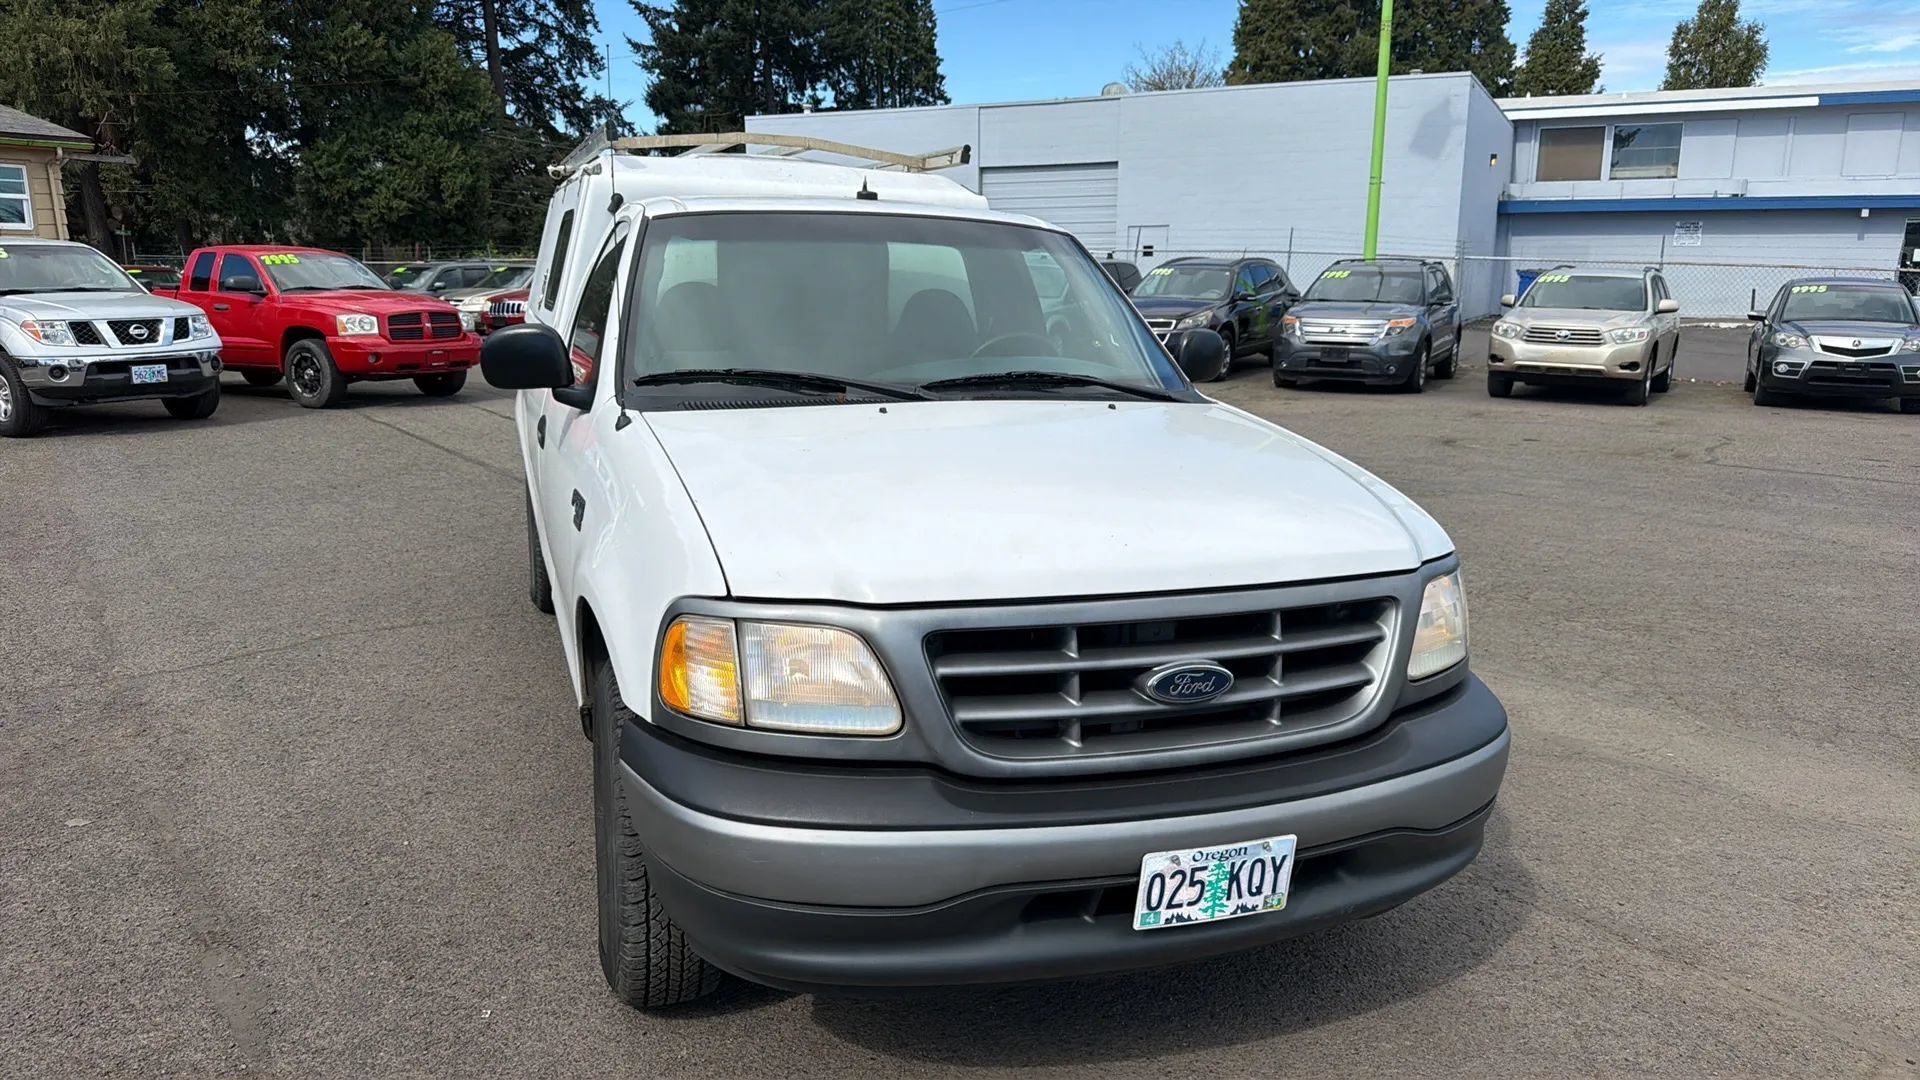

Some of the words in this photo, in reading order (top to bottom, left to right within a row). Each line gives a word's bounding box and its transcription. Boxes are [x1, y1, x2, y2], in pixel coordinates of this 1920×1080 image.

[260, 254, 300, 265] 7995
[1791, 285, 1828, 294] 9995
[1169, 672, 1216, 696] Ford
[1192, 846, 1248, 863] Oregon
[1146, 865, 1208, 912] 025
[1226, 854, 1289, 902] KQY
